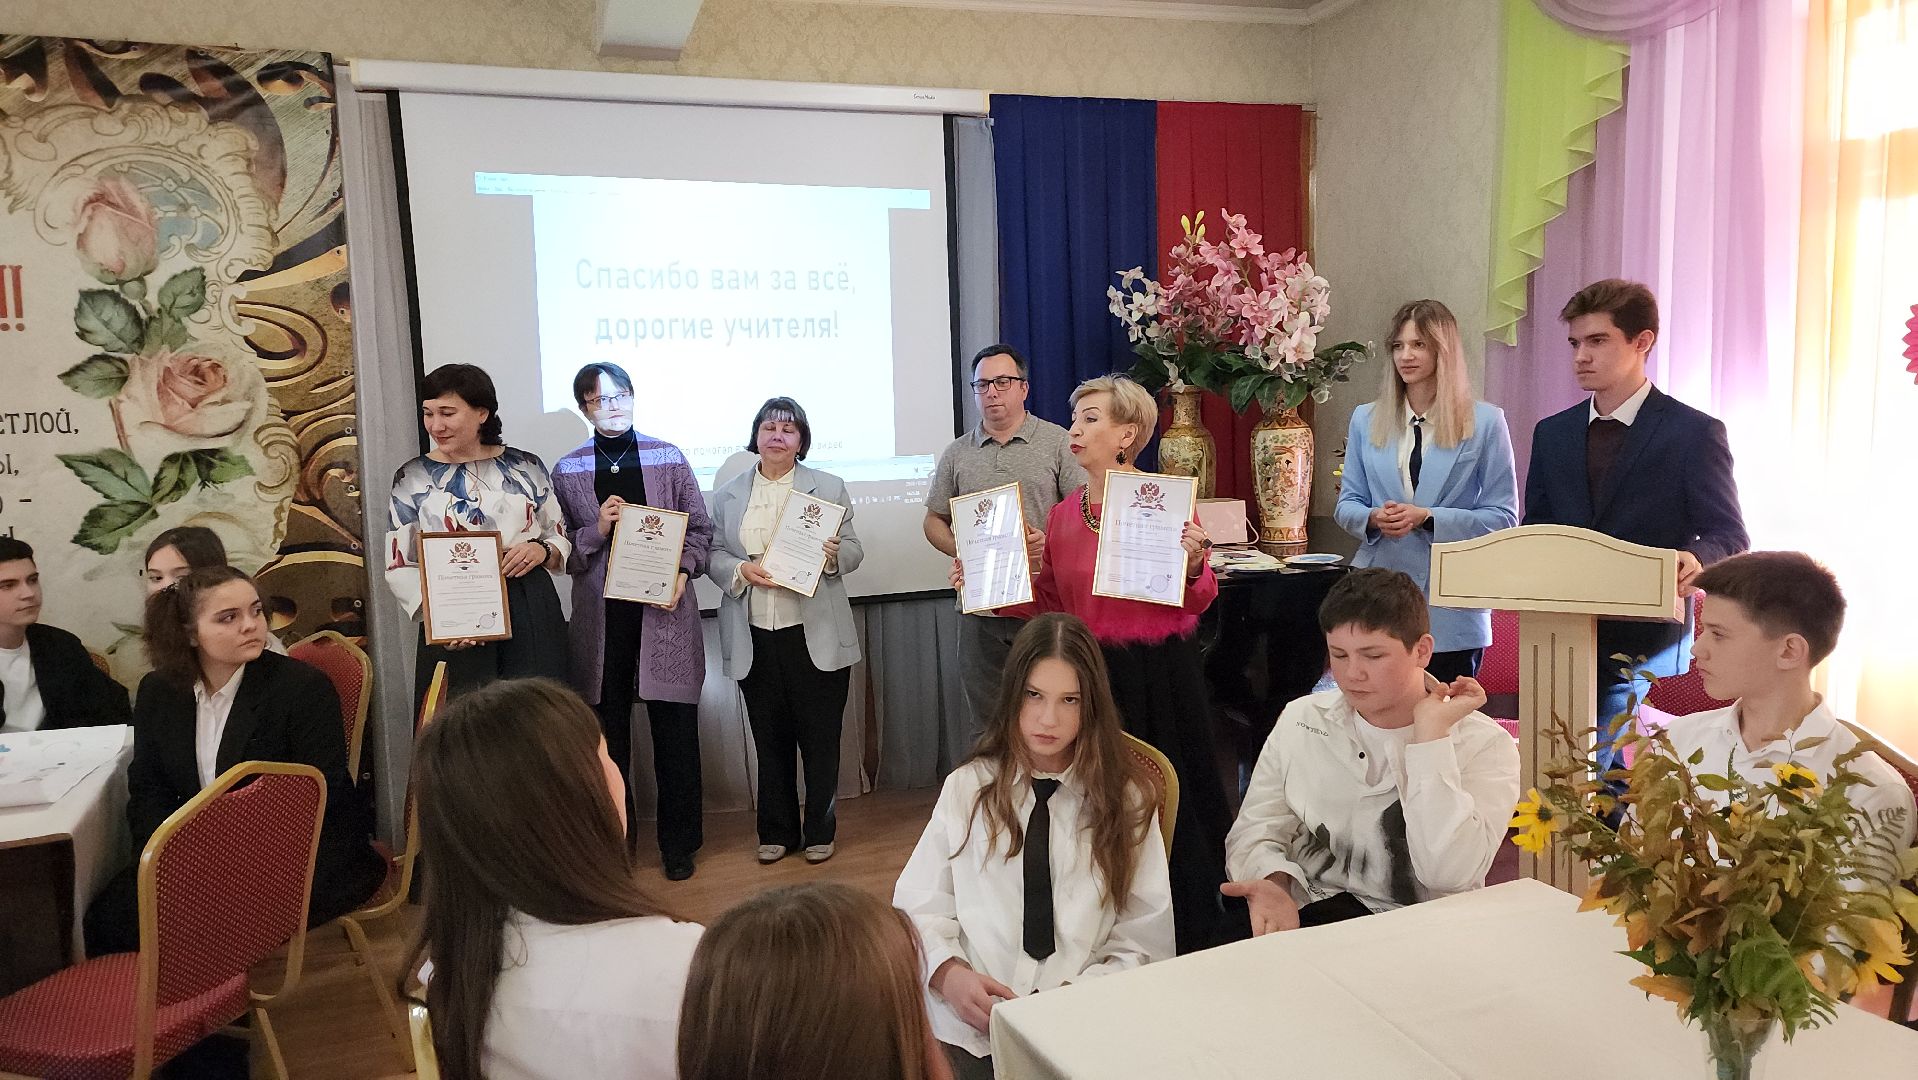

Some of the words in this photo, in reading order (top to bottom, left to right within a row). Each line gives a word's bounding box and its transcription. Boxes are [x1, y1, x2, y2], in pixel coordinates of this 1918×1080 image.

[576, 258, 699, 290] Спасибо
[711, 268, 760, 290] вам
[770, 269, 797, 290] за
[807, 262, 856, 295] всё,
[595, 316, 713, 348] дорогие
[723, 310, 839, 347] учителя!
